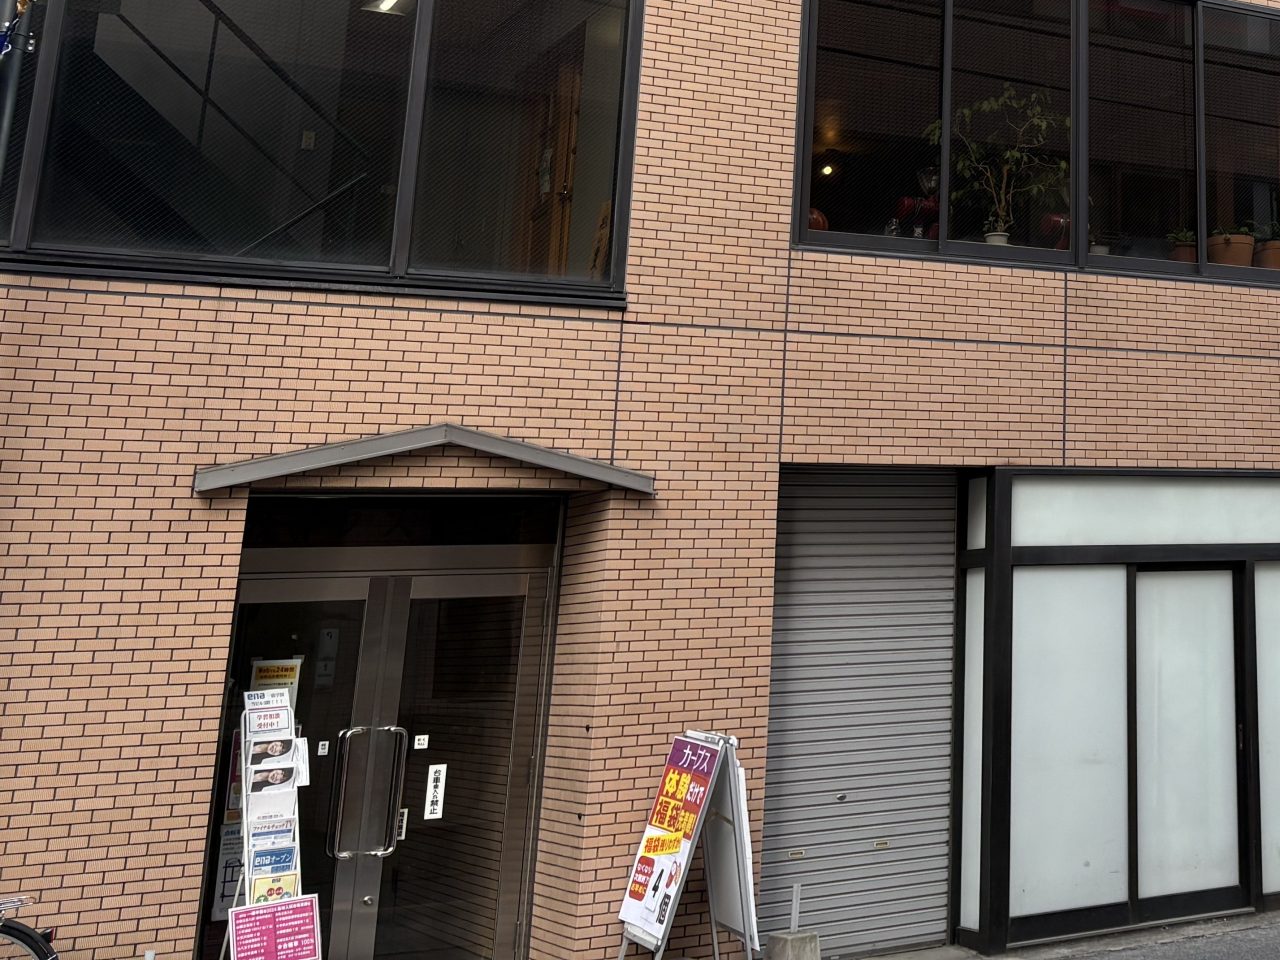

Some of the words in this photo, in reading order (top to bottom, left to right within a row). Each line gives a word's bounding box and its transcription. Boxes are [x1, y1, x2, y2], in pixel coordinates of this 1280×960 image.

[678, 744, 711, 773] カーブス
[662, 769, 705, 805] 体験だけで
[651, 868, 665, 898] 4
